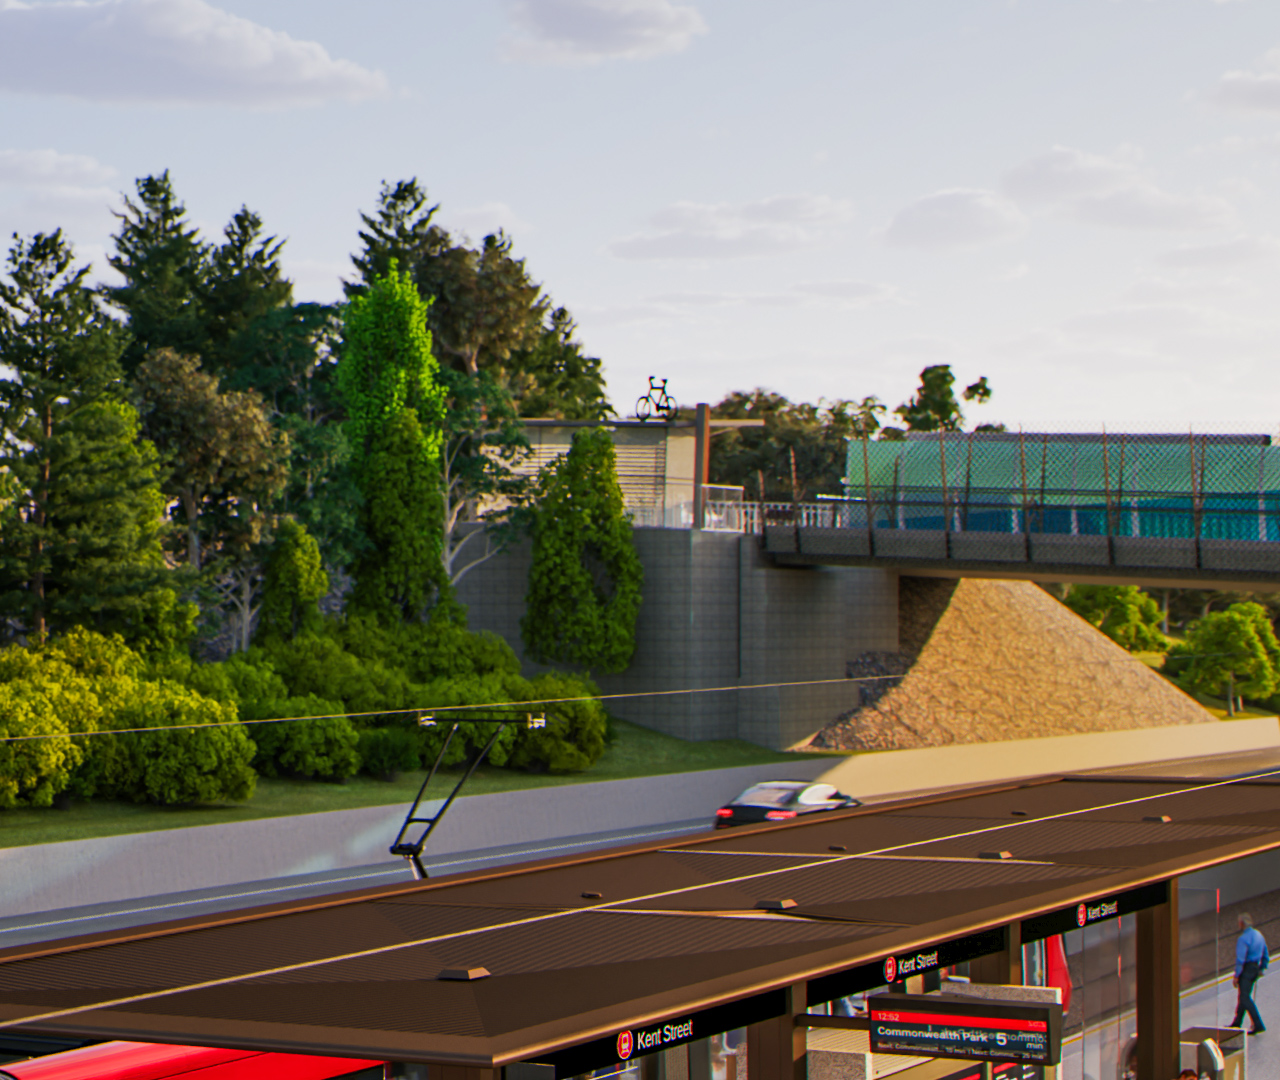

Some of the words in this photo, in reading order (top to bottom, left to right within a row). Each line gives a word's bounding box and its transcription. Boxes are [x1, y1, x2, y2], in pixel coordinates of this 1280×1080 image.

[898, 957, 916, 974] Kent
[916, 950, 938, 970] Street
[877, 1012, 900, 1022] 12:52
[637, 1029, 662, 1050] Kent
[663, 1019, 693, 1042] Street
[877, 1026, 961, 1042] Commonwealth
[964, 1032, 989, 1044] Park
[995, 1031, 1008, 1047] 5
[1026, 1040, 1044, 1050] min
